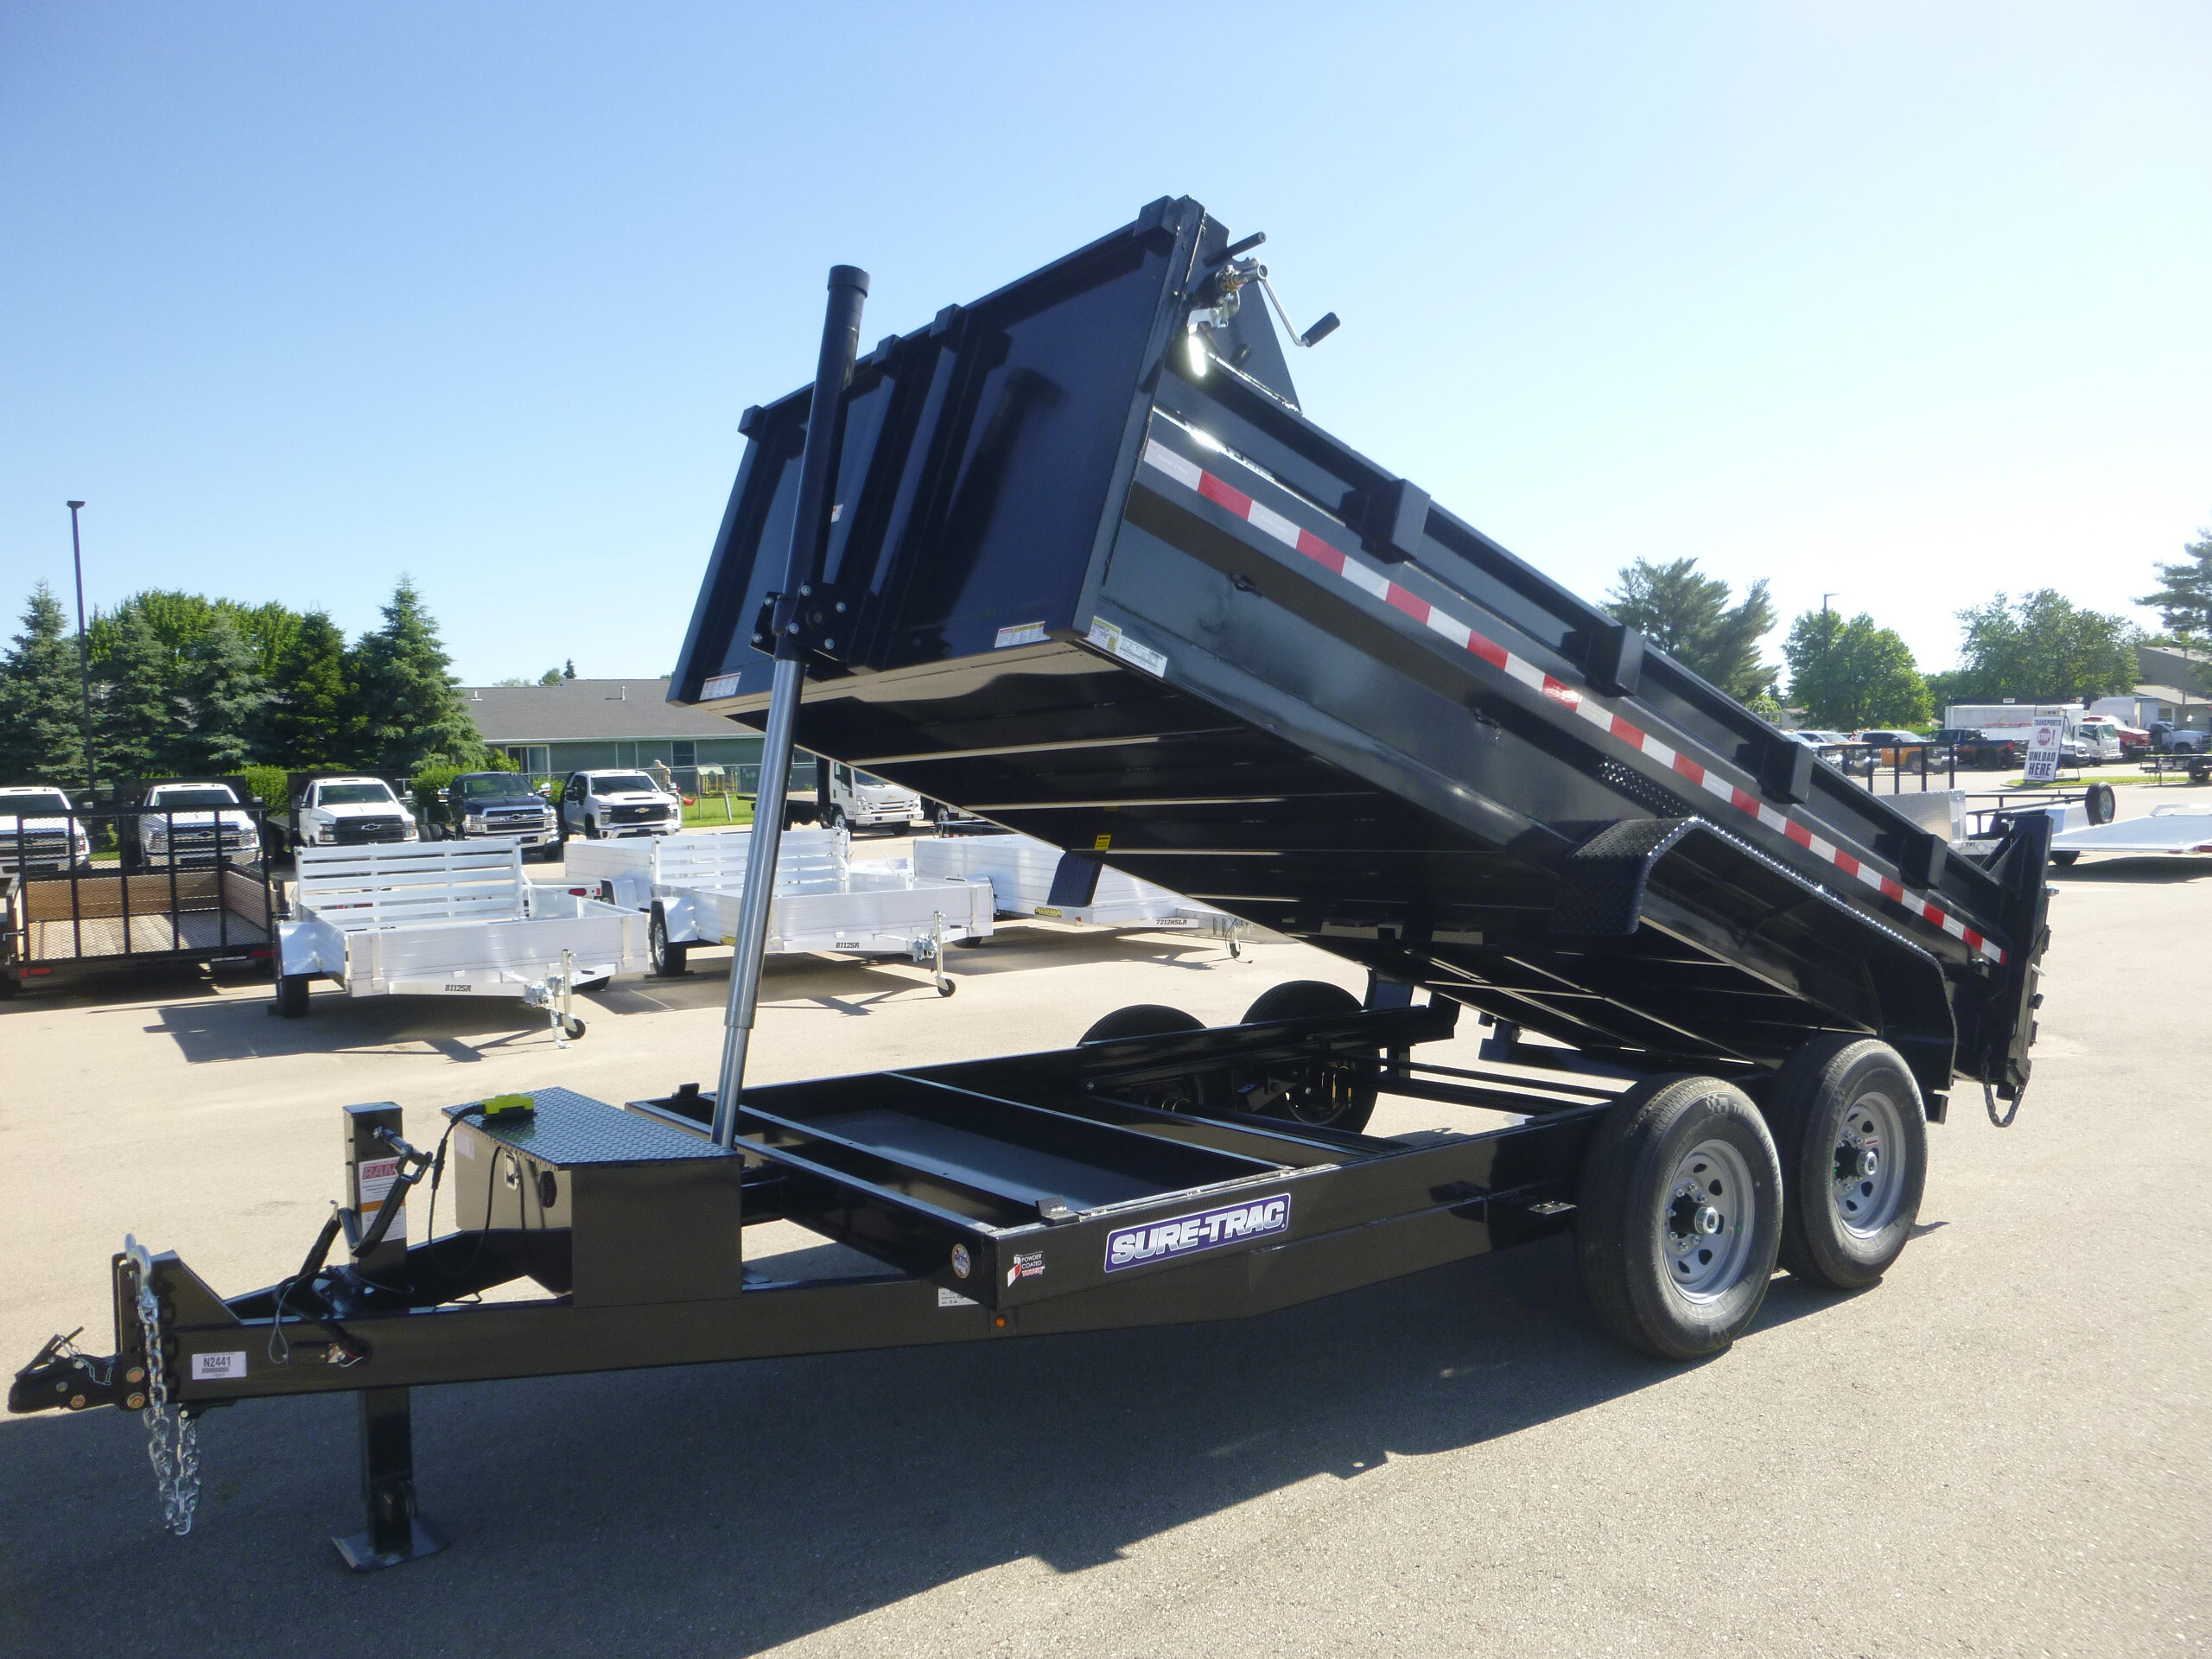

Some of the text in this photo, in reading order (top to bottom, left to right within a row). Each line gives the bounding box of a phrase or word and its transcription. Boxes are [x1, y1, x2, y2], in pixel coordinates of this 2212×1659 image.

[2037, 733, 2051, 741] STOP
[2028, 751, 2056, 762] UNLOAD
[2028, 763, 2051, 776] HERE
[1111, 1200, 1285, 1264] SURE-TRAC
[1021, 1253, 1042, 1263] POWDER
[1021, 1260, 1042, 1269] COATED
[203, 1356, 231, 1367] N2441
